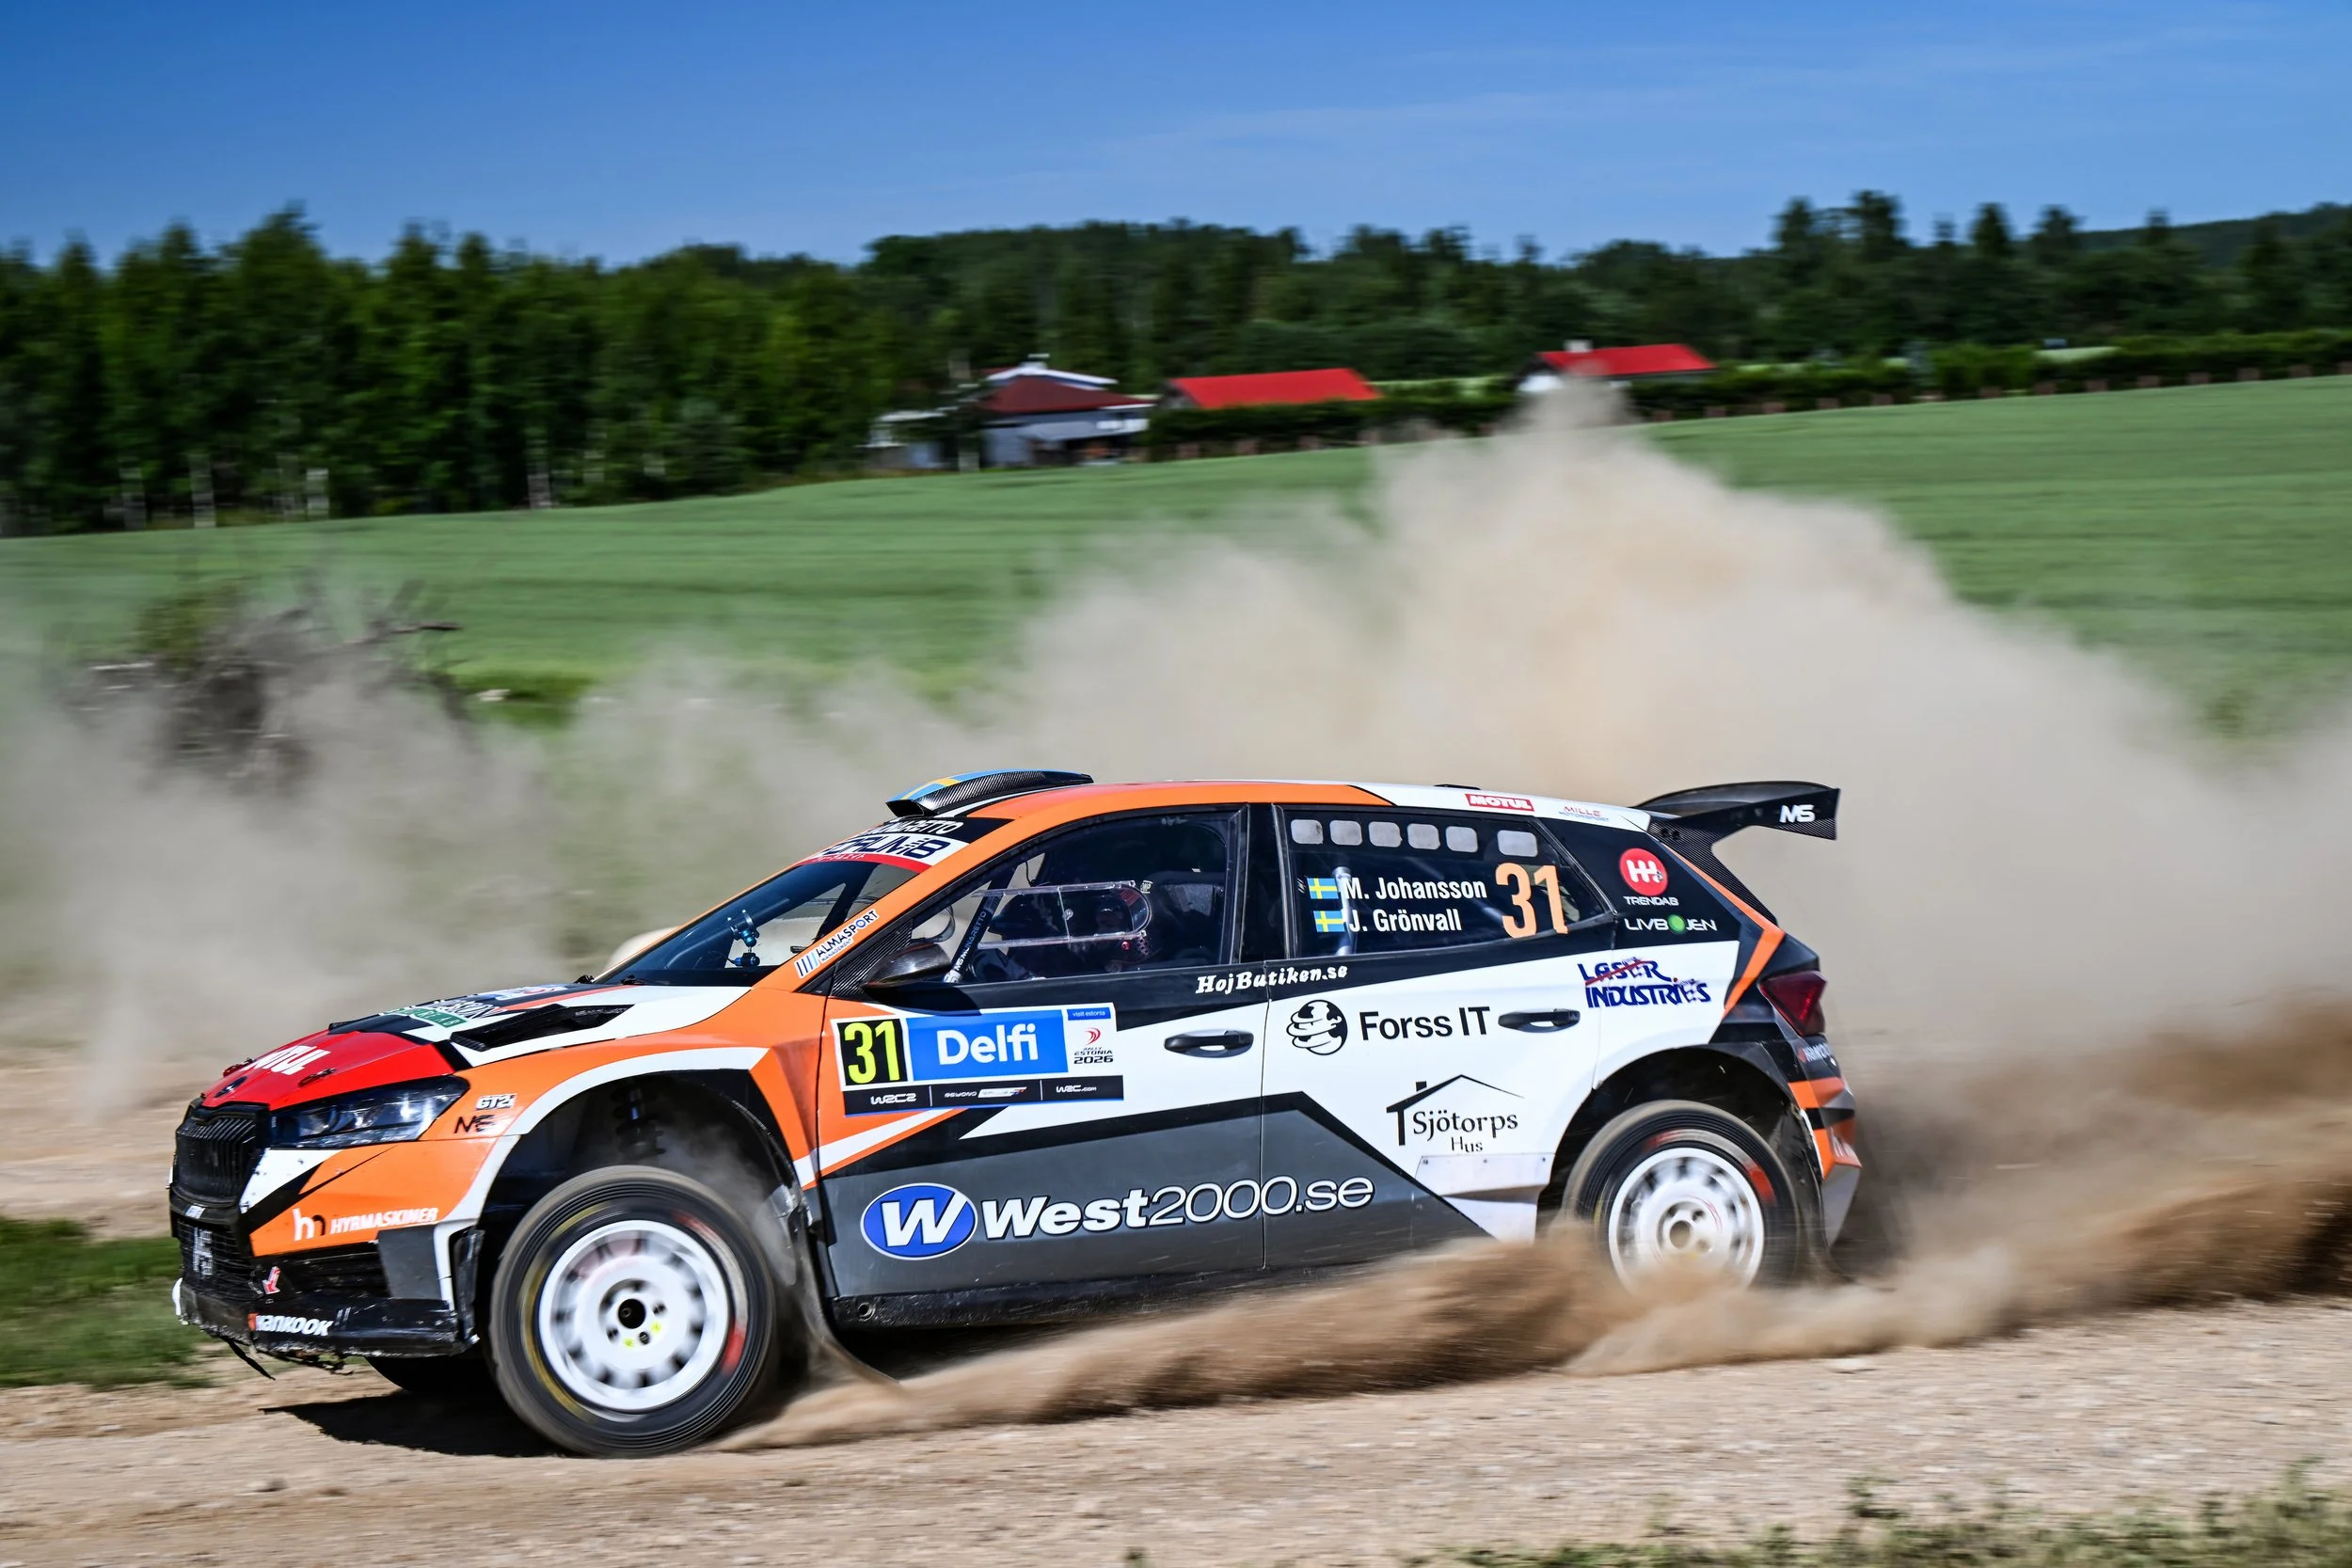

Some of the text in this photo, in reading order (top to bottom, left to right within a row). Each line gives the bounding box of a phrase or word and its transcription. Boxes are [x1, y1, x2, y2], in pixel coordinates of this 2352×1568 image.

[1469, 795, 1532, 809] MOTUL
[1779, 803, 1816, 823] MS
[1343, 877, 1487, 900] M. Johansson
[1495, 863, 1568, 939] 31
[1623, 896, 1679, 907] TRENDAB
[816, 911, 878, 958] ALMASPORT
[1348, 908, 1462, 933] J. Grönvall
[1195, 965, 1348, 995] HojButiken.se
[1584, 979, 1711, 1008] INDUSTRIES
[1359, 1006, 1491, 1041] Forss IT
[844, 1021, 900, 1085] 31
[936, 1023, 1039, 1066] Delfi
[1073, 1055, 1114, 1065] 2026
[870, 1092, 917, 1105] WRC2
[1412, 1109, 1518, 1142] Sjötorps
[1451, 1136, 1484, 1153] Hus
[330, 1208, 439, 1235] HYRMASKINER
[982, 1175, 1375, 1241] West2000.se
